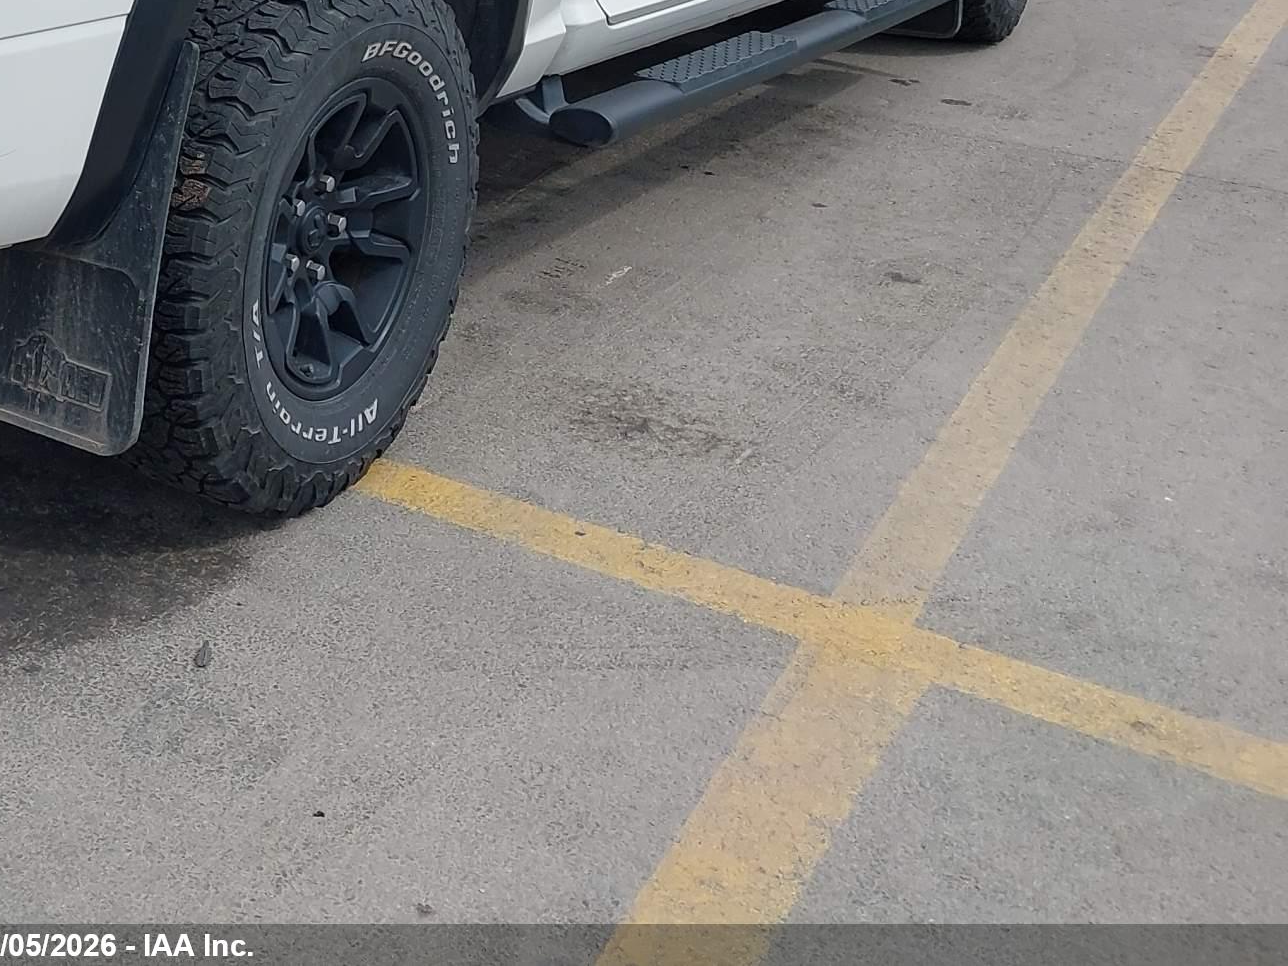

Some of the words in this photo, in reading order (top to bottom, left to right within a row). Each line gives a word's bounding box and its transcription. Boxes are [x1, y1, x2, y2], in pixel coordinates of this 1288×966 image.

[361, 40, 460, 164] BFGoodrich
[251, 297, 264, 370] T/A
[266, 381, 379, 445] All-Terrain
